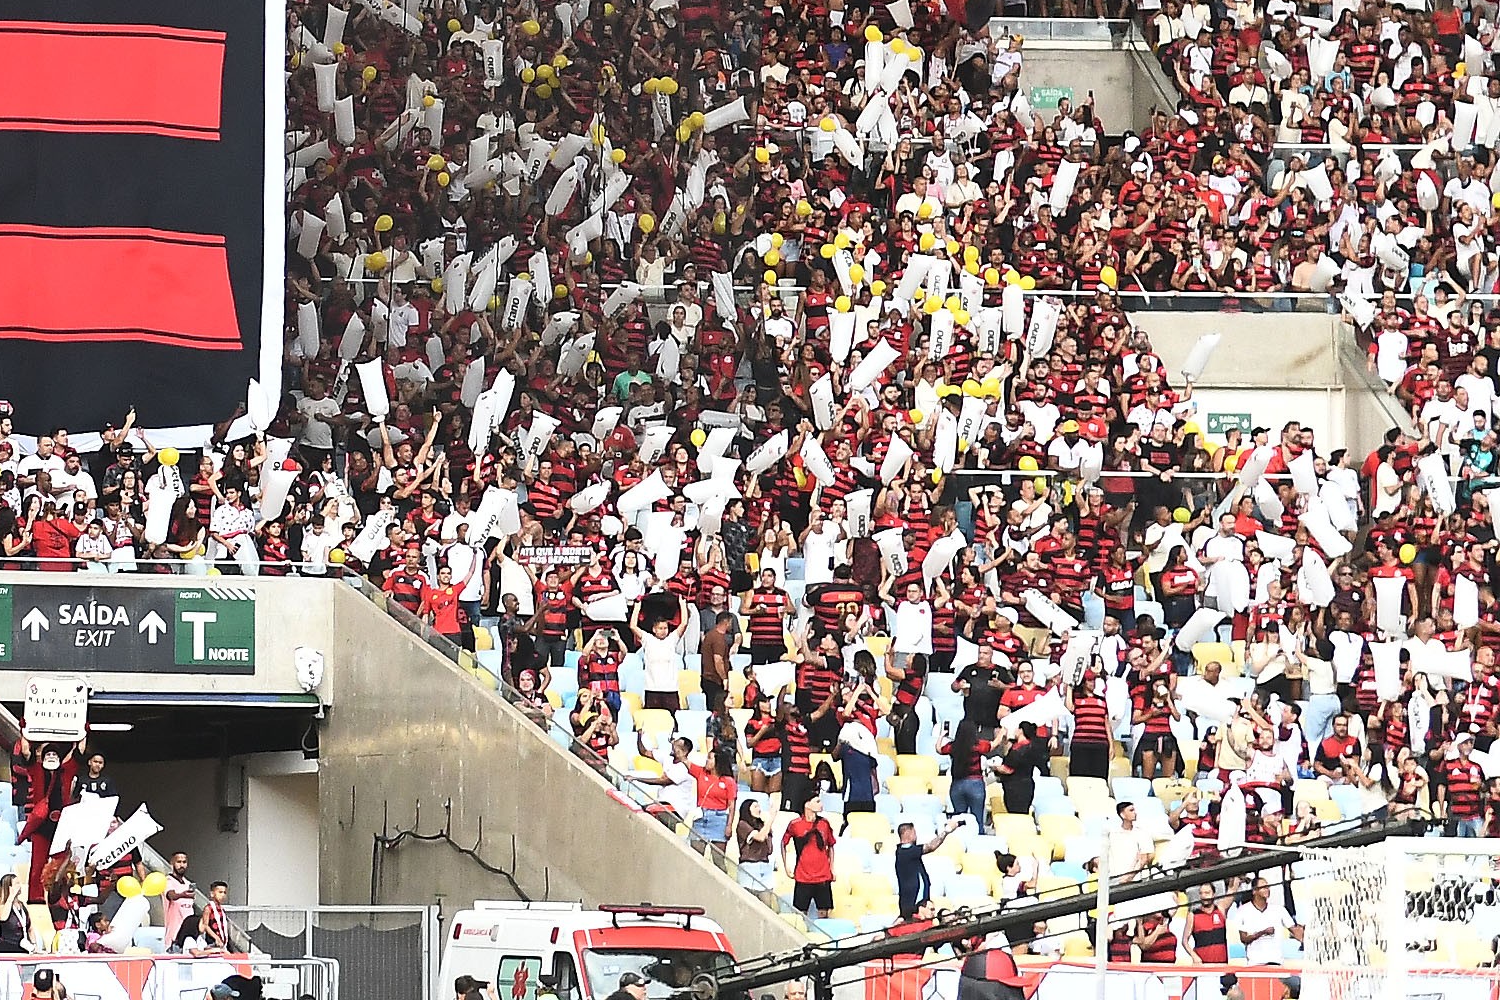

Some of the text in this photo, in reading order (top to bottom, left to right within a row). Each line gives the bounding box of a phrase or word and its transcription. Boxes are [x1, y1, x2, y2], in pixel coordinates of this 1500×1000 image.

[58, 600, 130, 626] SAÍDA
[74, 629, 115, 647] EXIT
[181, 612, 217, 660] T
[208, 648, 249, 661] NORTE
[97, 836, 138, 871] etano
